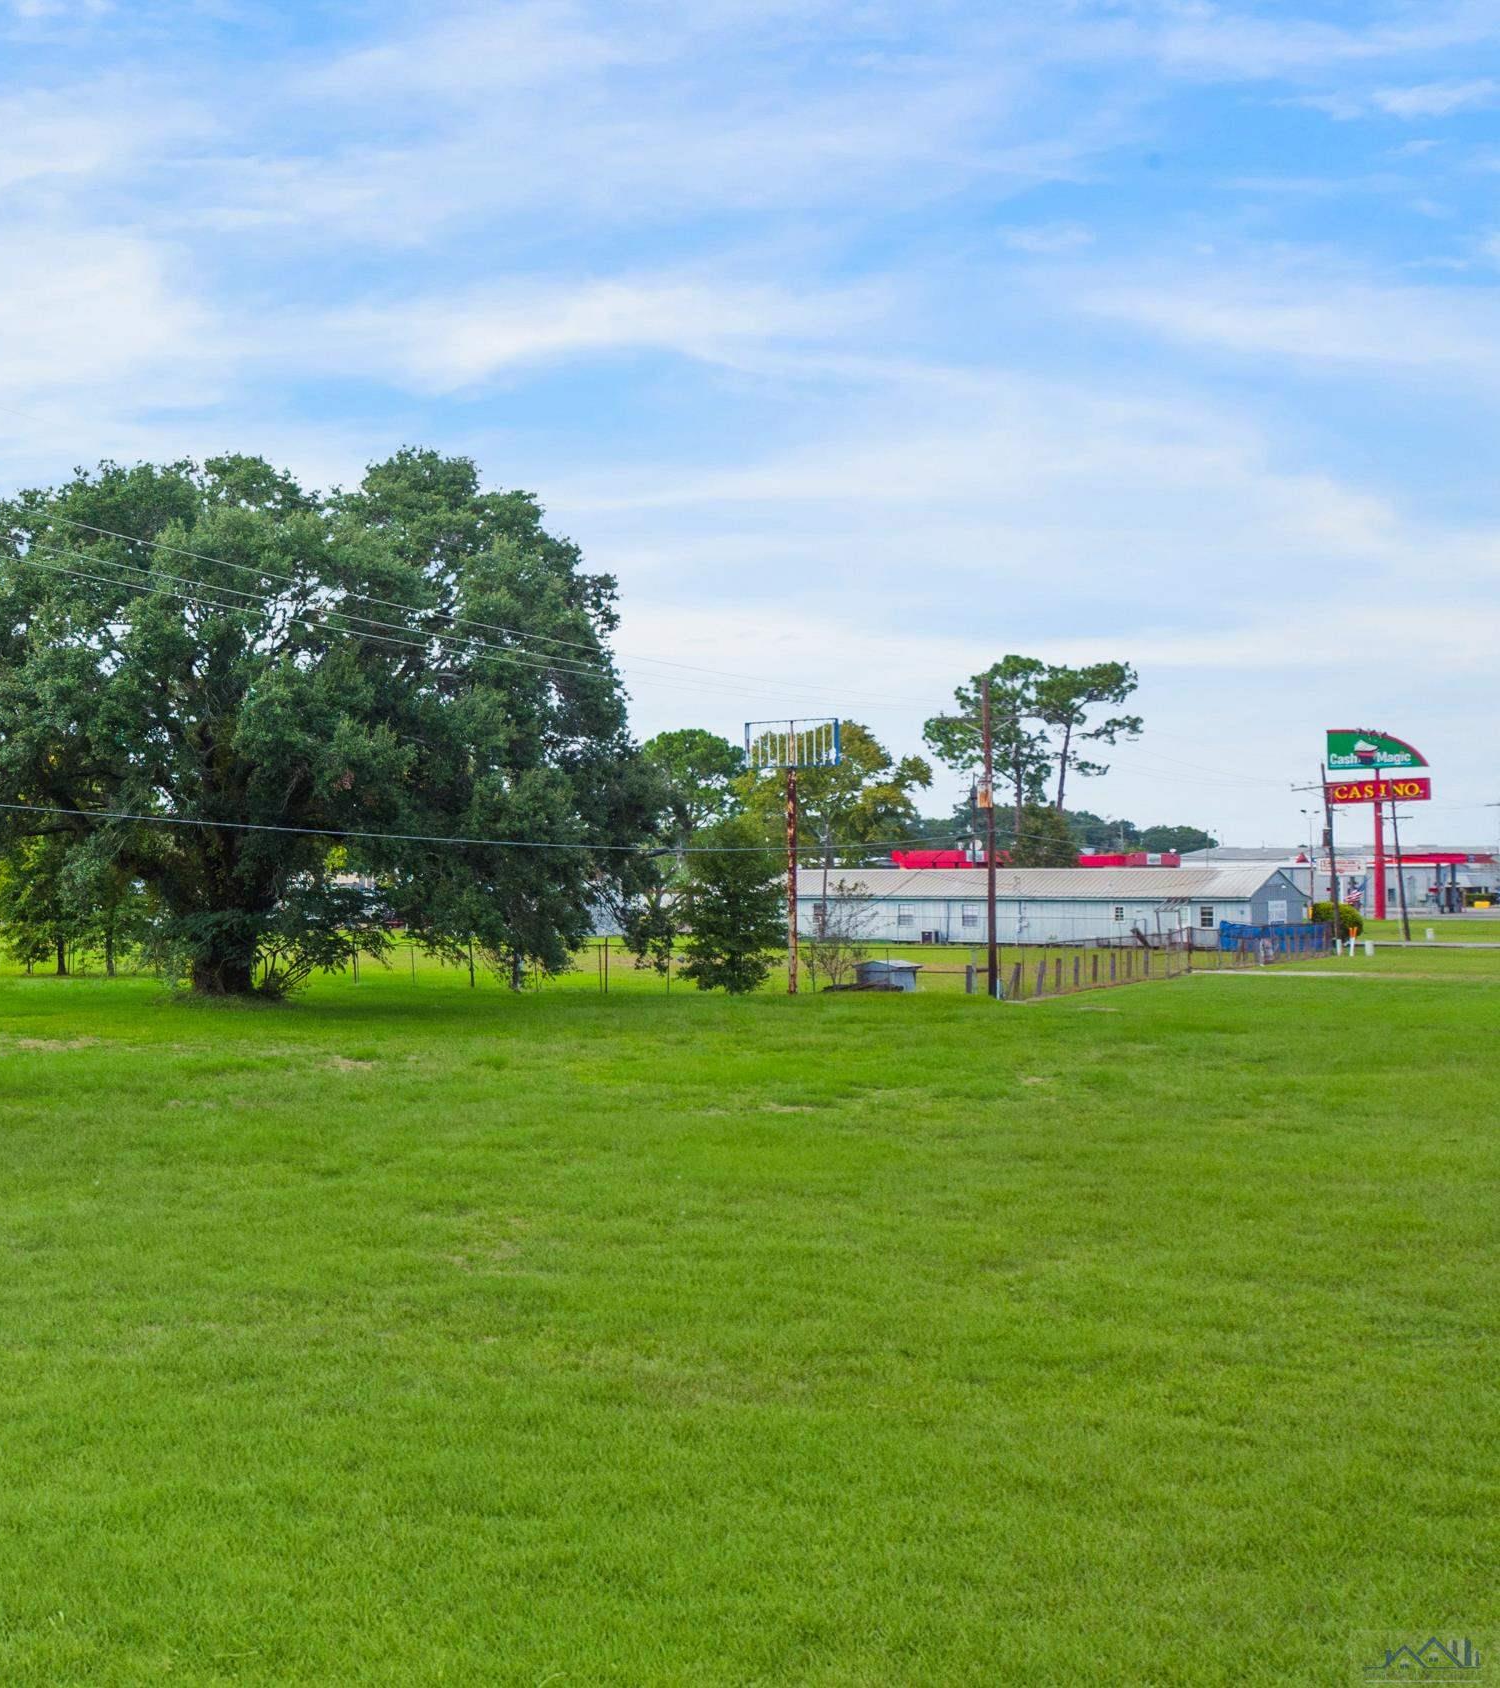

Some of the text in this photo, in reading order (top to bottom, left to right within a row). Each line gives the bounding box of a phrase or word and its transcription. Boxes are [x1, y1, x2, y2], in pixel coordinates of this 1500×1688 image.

[1330, 751, 1411, 765] Cash Magic
[1334, 783, 1420, 799] CASINO
